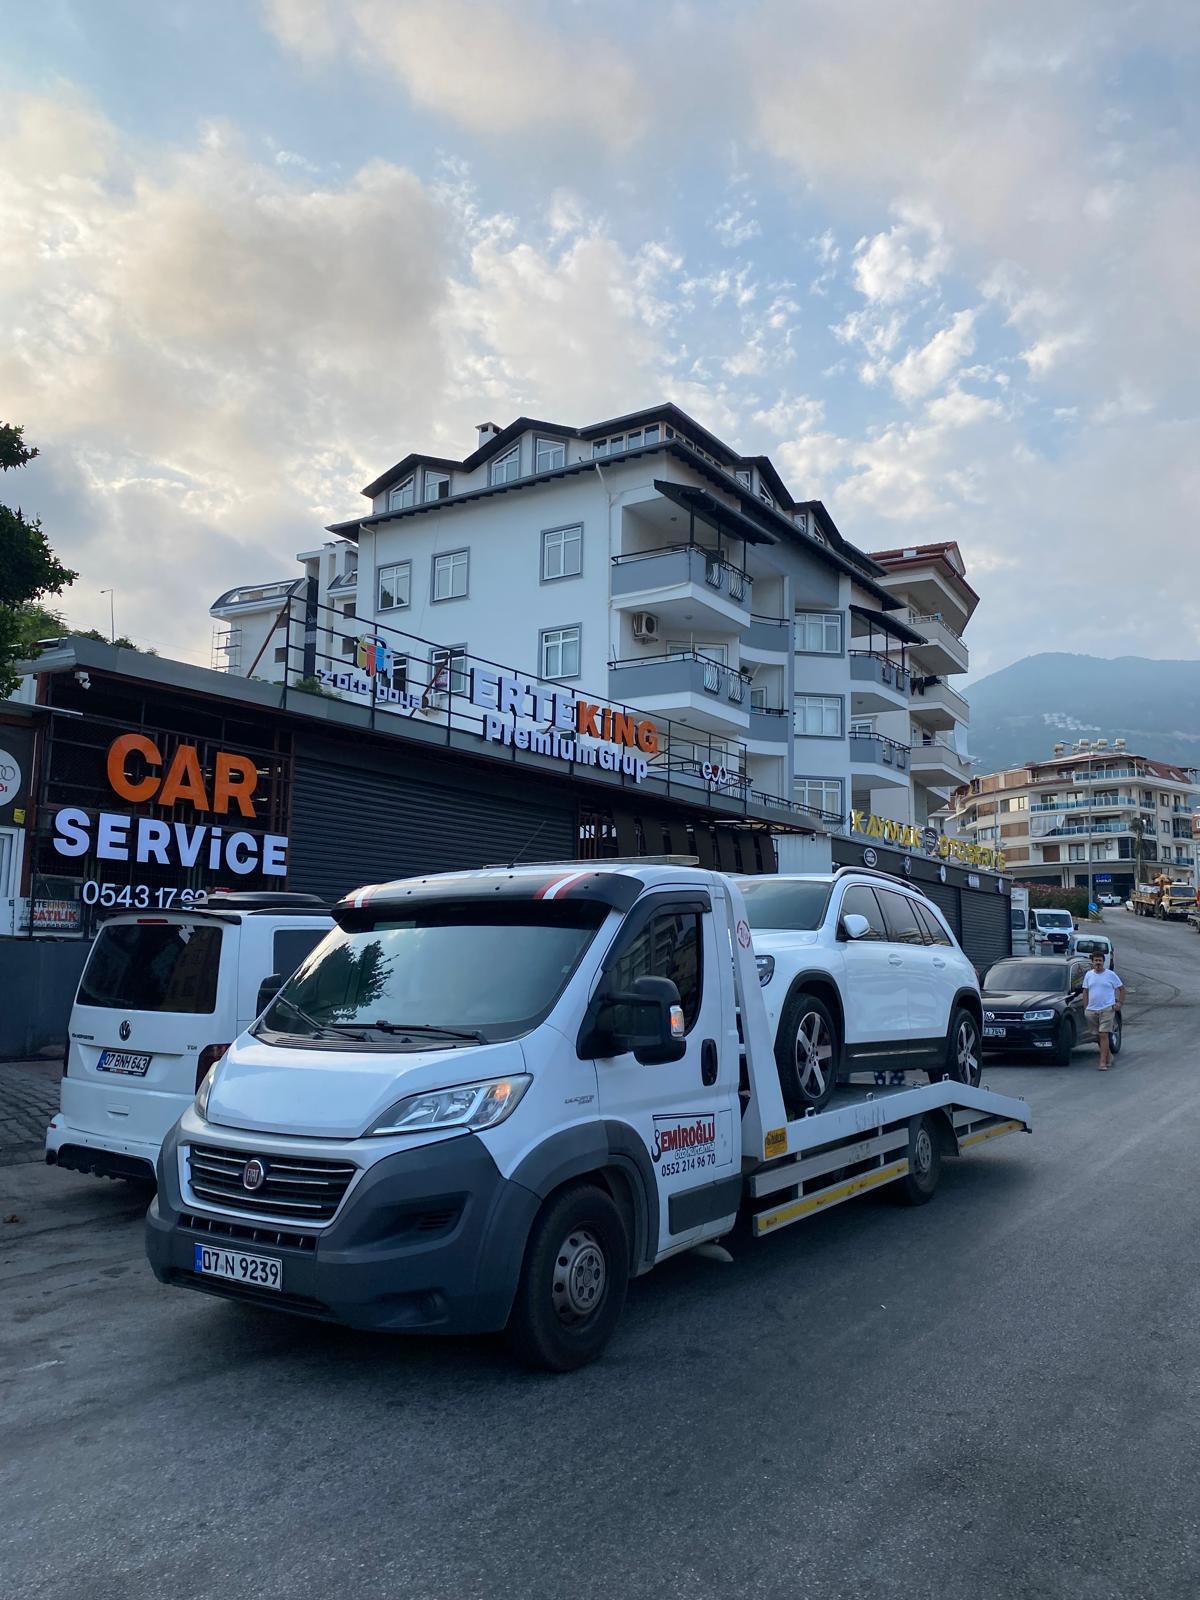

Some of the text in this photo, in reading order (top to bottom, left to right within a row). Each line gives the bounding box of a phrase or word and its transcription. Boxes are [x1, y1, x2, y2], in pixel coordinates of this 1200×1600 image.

[483, 714, 649, 784] Premium Grup
[107, 733, 258, 818] CAR
[82, 880, 149, 909] 0543
[154, 887, 178, 909] 17
[104, 1053, 149, 1071] 07 BNH 643
[247, 1168, 260, 1183] FIAT
[661, 1153, 716, 1177] 0552 214 96 70
[202, 1250, 278, 1285] 07 N 9239
